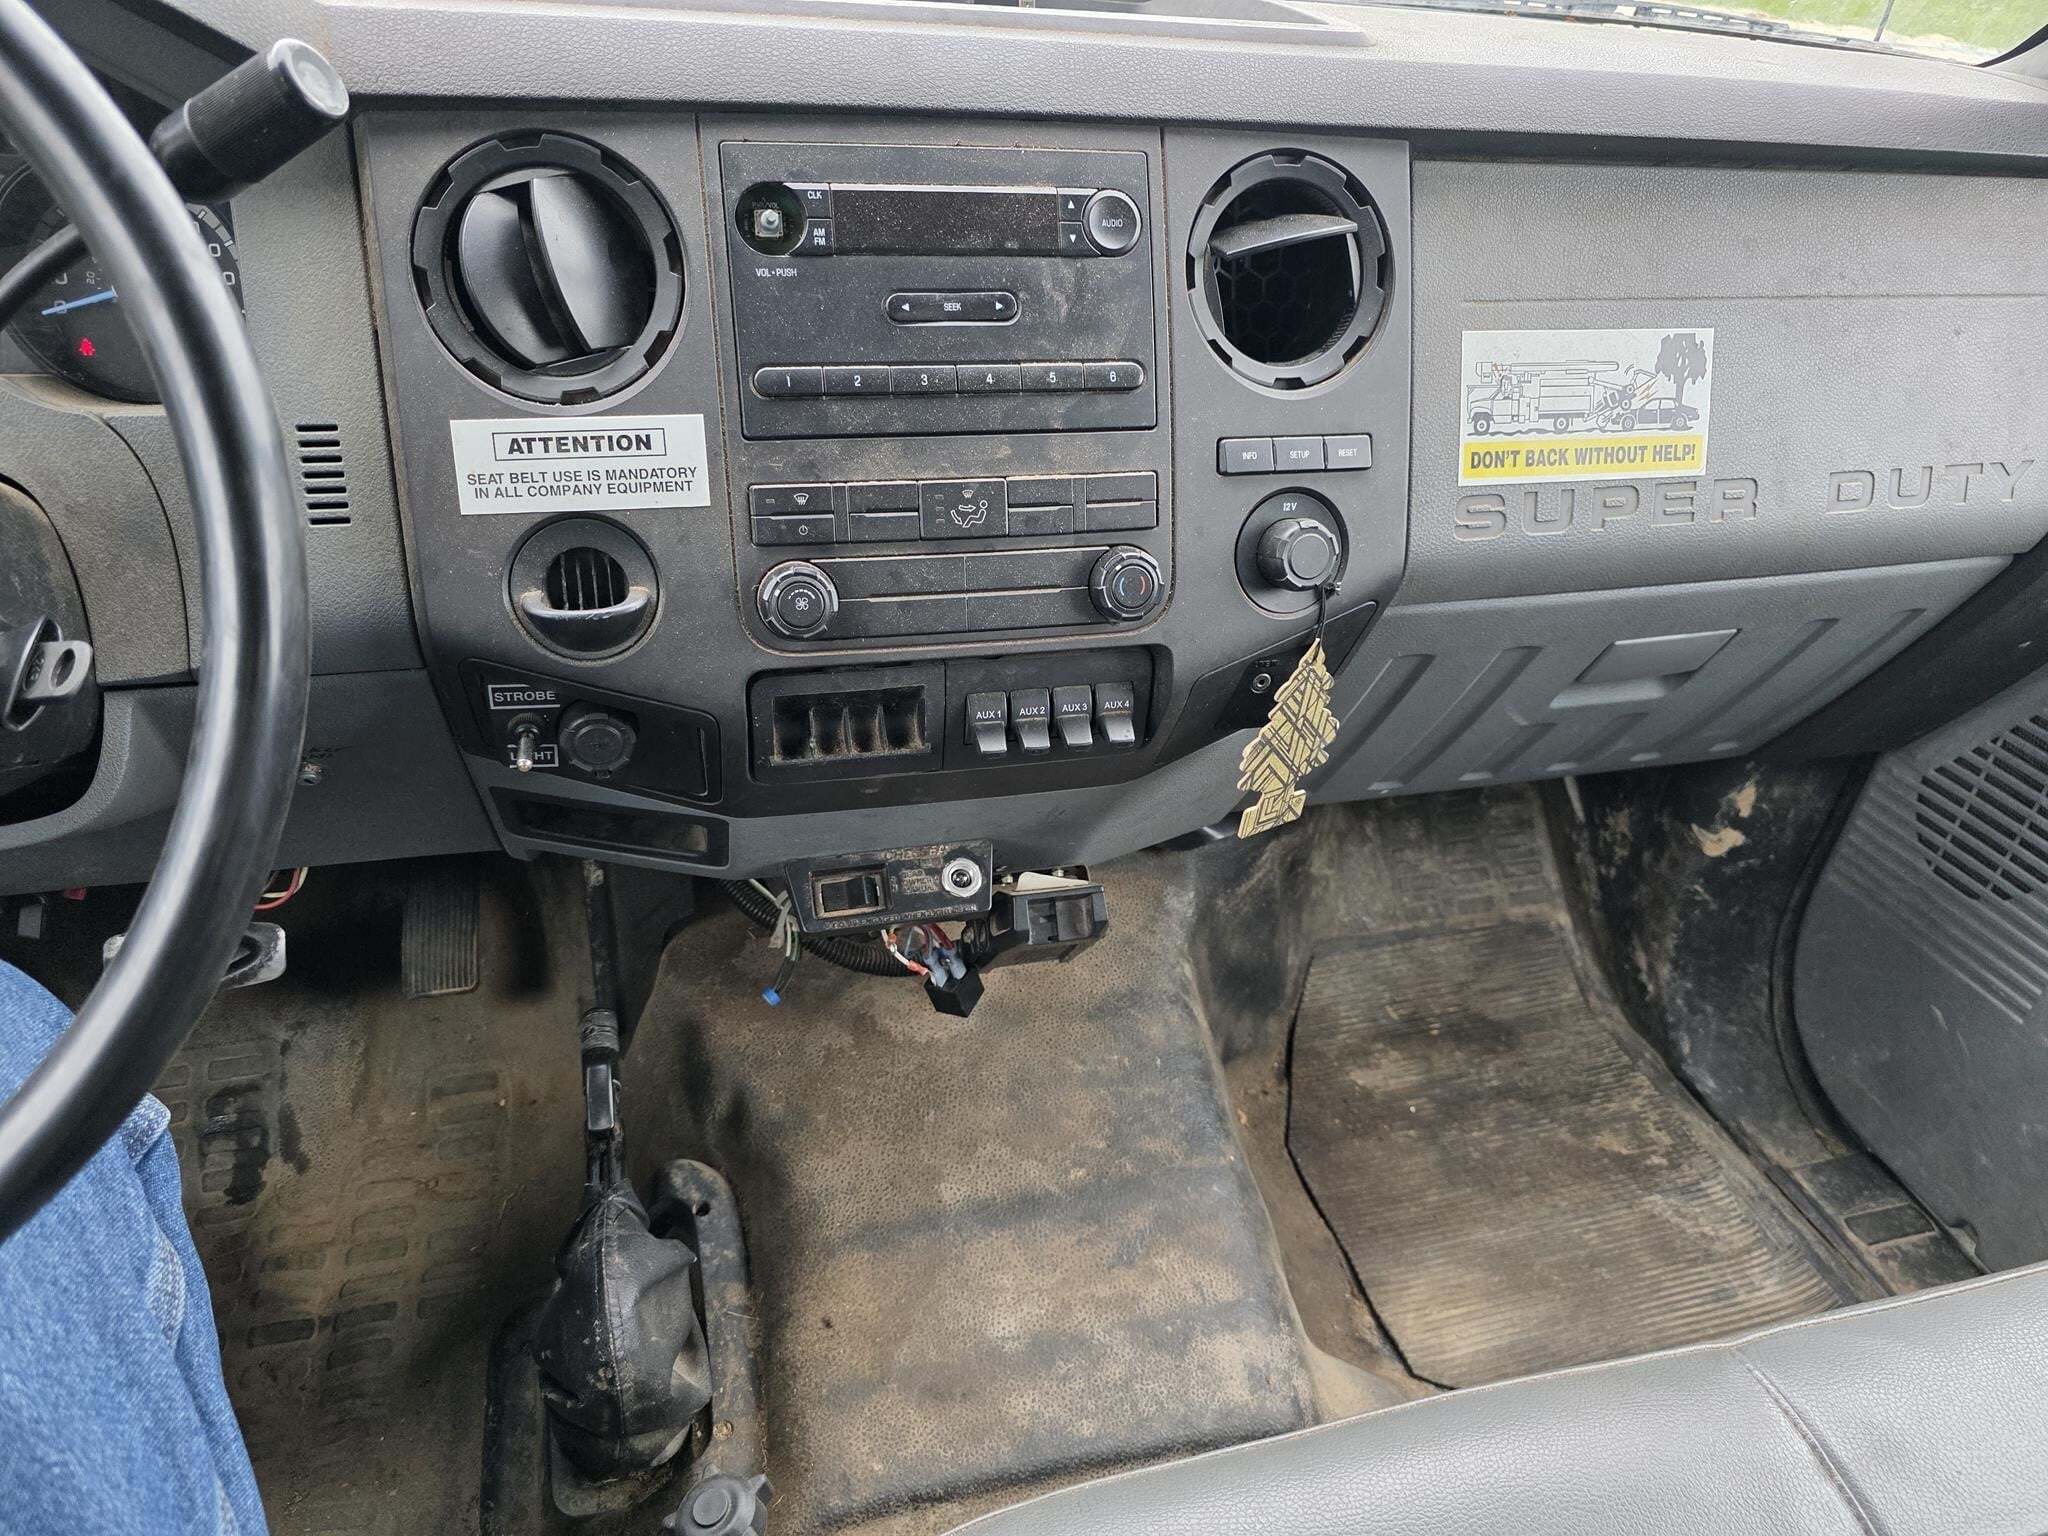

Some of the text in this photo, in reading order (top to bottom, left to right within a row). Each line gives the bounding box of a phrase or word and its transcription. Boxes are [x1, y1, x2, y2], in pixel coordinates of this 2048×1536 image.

[807, 190, 823, 200] CLK
[1101, 218, 1123, 228] AUDIO
[813, 228, 826, 237] AM
[814, 237, 826, 246] FM
[943, 302, 962, 312] SEEK
[785, 375, 791, 388] 1
[853, 375, 861, 387] 2
[920, 374, 928, 386] 3
[986, 373, 995, 385] 4
[1050, 372, 1057, 383] 5
[1109, 371, 1117, 382] 6
[507, 433, 653, 455] ATTENTION
[1242, 451, 1257, 460] INFO
[1289, 450, 1310, 459] SETUP
[1338, 448, 1358, 457] RESET
[1470, 443, 1696, 470] DON'T BACK WITHOUT HELP!
[467, 466, 697, 486] SEAT BELT USE IS MANDATORY
[474, 480, 694, 499] IN ALL COMPANY EQUIPMENT
[1453, 460, 2035, 541] SUPER DUTY
[1282, 502, 1298, 511] 12V
[494, 691, 556, 702] STROBE
[1062, 703, 1088, 713] AUX 3
[1104, 700, 1130, 710] AUX 4
[976, 710, 1002, 720] AUX 1
[1019, 706, 1046, 717] AUX 2
[510, 751, 553, 761] LHT
